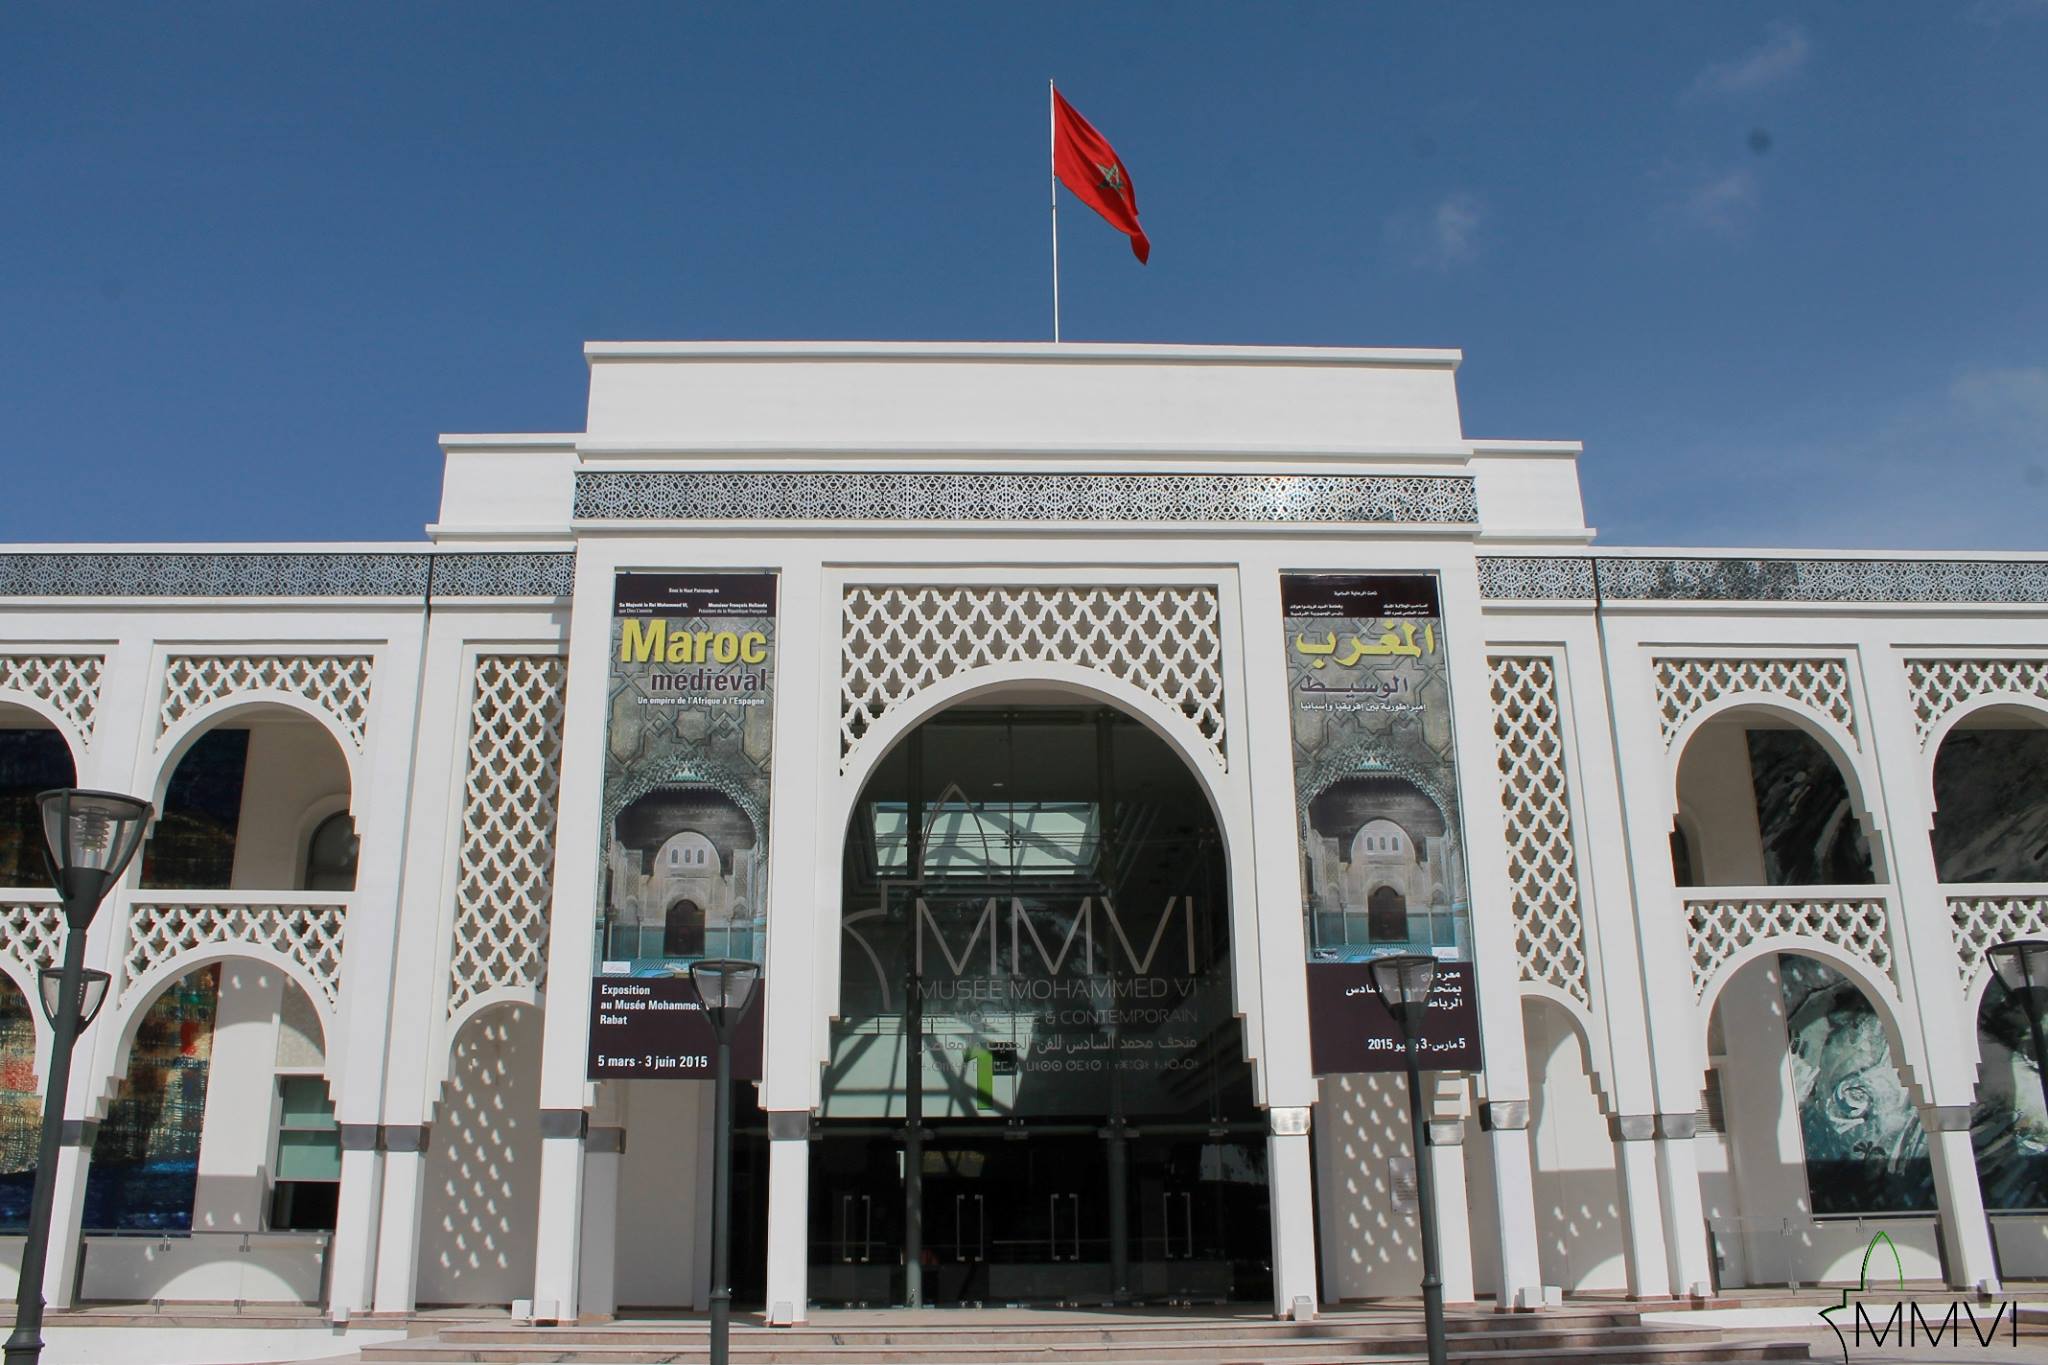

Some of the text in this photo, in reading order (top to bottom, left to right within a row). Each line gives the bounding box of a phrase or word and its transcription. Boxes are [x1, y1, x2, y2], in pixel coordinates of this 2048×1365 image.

[621, 619, 767, 664] Maroc
[1295, 619, 1436, 669] المغرب
[651, 668, 766, 691] médiéval
[1300, 674, 1408, 699] الوسيط
[638, 696, 765, 706] Un empire de l'Afrique à l'Espagne
[1366, 703, 1379, 712] بين
[916, 896, 1196, 976] MMVI
[601, 984, 650, 997] Exposition
[916, 976, 1198, 1000] MUSÉE MOHAMMED VI
[1424, 983, 1462, 996] بمتح
[600, 1001, 612, 1010] au
[614, 999, 646, 1010] Musée
[600, 1014, 628, 1025] Rabat
[1060, 1008, 1198, 1025] CONTEMPORAIN
[1036, 1033, 1062, 1054] للفن
[1066, 1033, 1114, 1054] السادس
[1120, 1037, 1154, 1049] محمد
[1158, 1032, 1198, 1049] متحف
[1368, 1038, 1393, 1050] 2015
[1420, 1038, 1427, 1049] 3
[1432, 1040, 1458, 1051] مارس
[1458, 1037, 1466, 1049] 5
[1394, 1043, 1419, 1052] ييو
[598, 1056, 605, 1067] 5
[608, 1057, 635, 1067] mars
[645, 1056, 652, 1067] 3
[655, 1056, 676, 1070] juin
[679, 1056, 708, 1068] 2015
